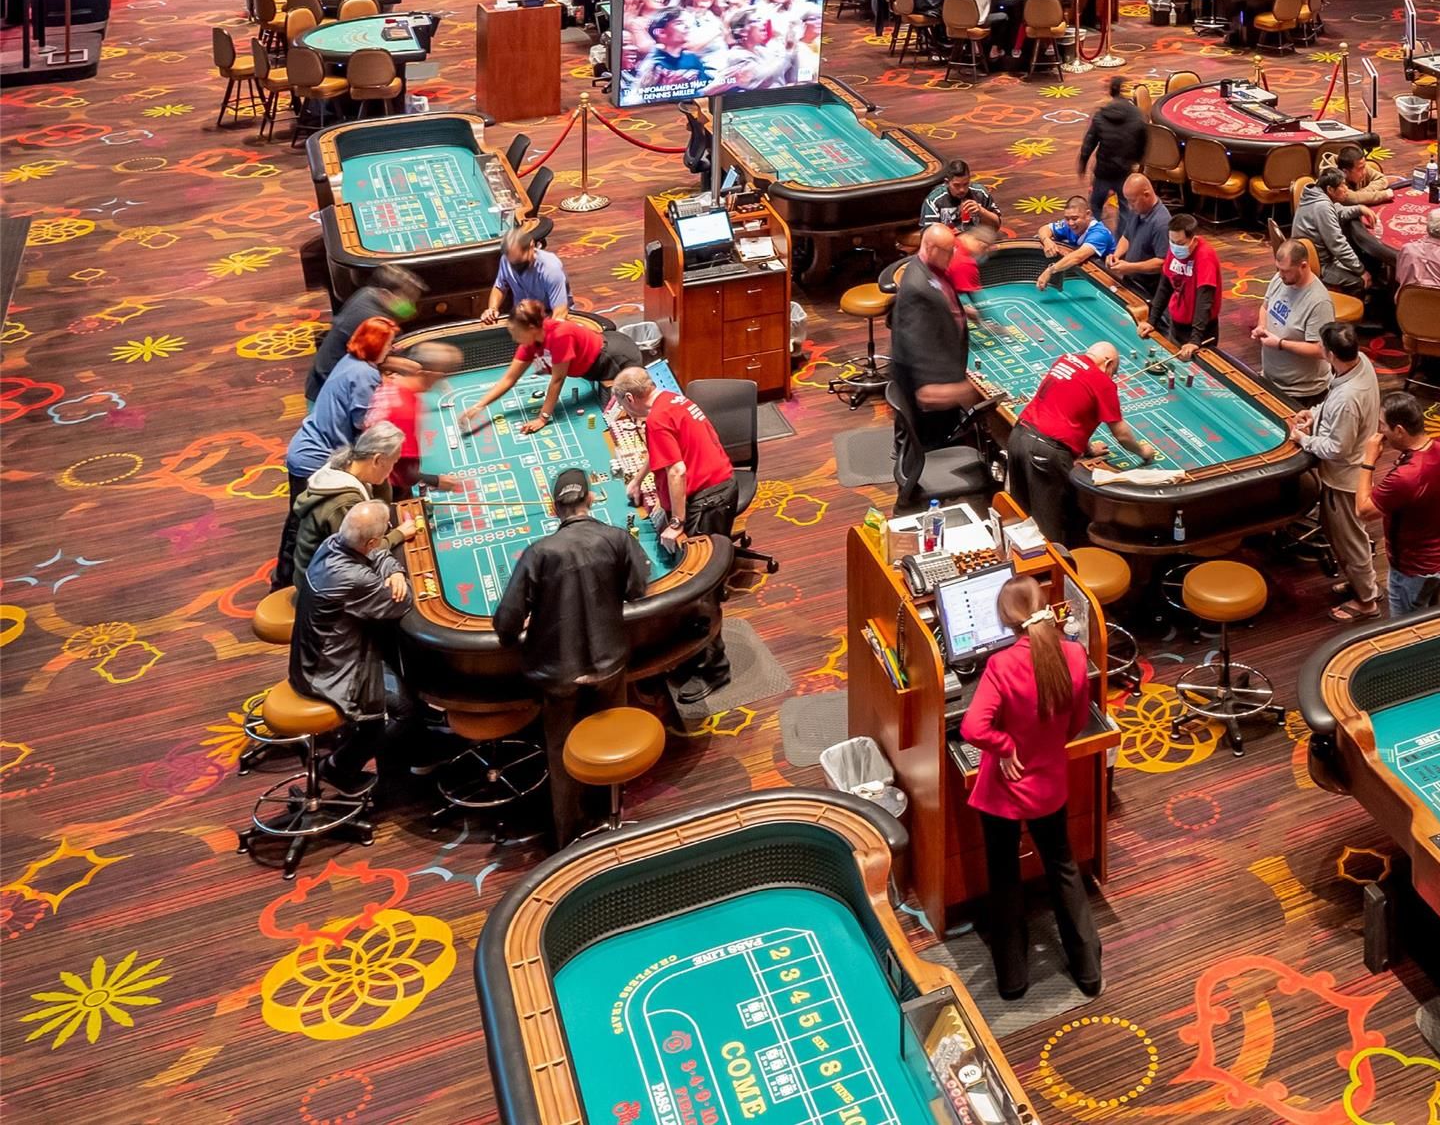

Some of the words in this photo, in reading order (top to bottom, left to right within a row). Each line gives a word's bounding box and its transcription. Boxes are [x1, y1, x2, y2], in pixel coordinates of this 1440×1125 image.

[638, 82, 689, 94] INFOMERCIALS
[690, 80, 707, 89] THAT
[643, 90, 671, 100] DENNIS
[672, 88, 695, 97] MILLER
[1273, 299, 1292, 319] CUBS
[728, 937, 764, 954] PASS
[769, 946, 791, 961] 2
[692, 948, 726, 966] LINE
[619, 954, 678, 1000] CRAPLESS
[779, 968, 801, 982] 3
[789, 989, 812, 1004] 4
[610, 1001, 625, 1035] CRAPS
[798, 1011, 823, 1028] 5
[811, 1034, 830, 1052] SIX
[819, 1059, 843, 1076] 8
[720, 1041, 768, 1118] COME
[652, 1082, 668, 1114] PASS
[831, 1081, 855, 1104] NINE
